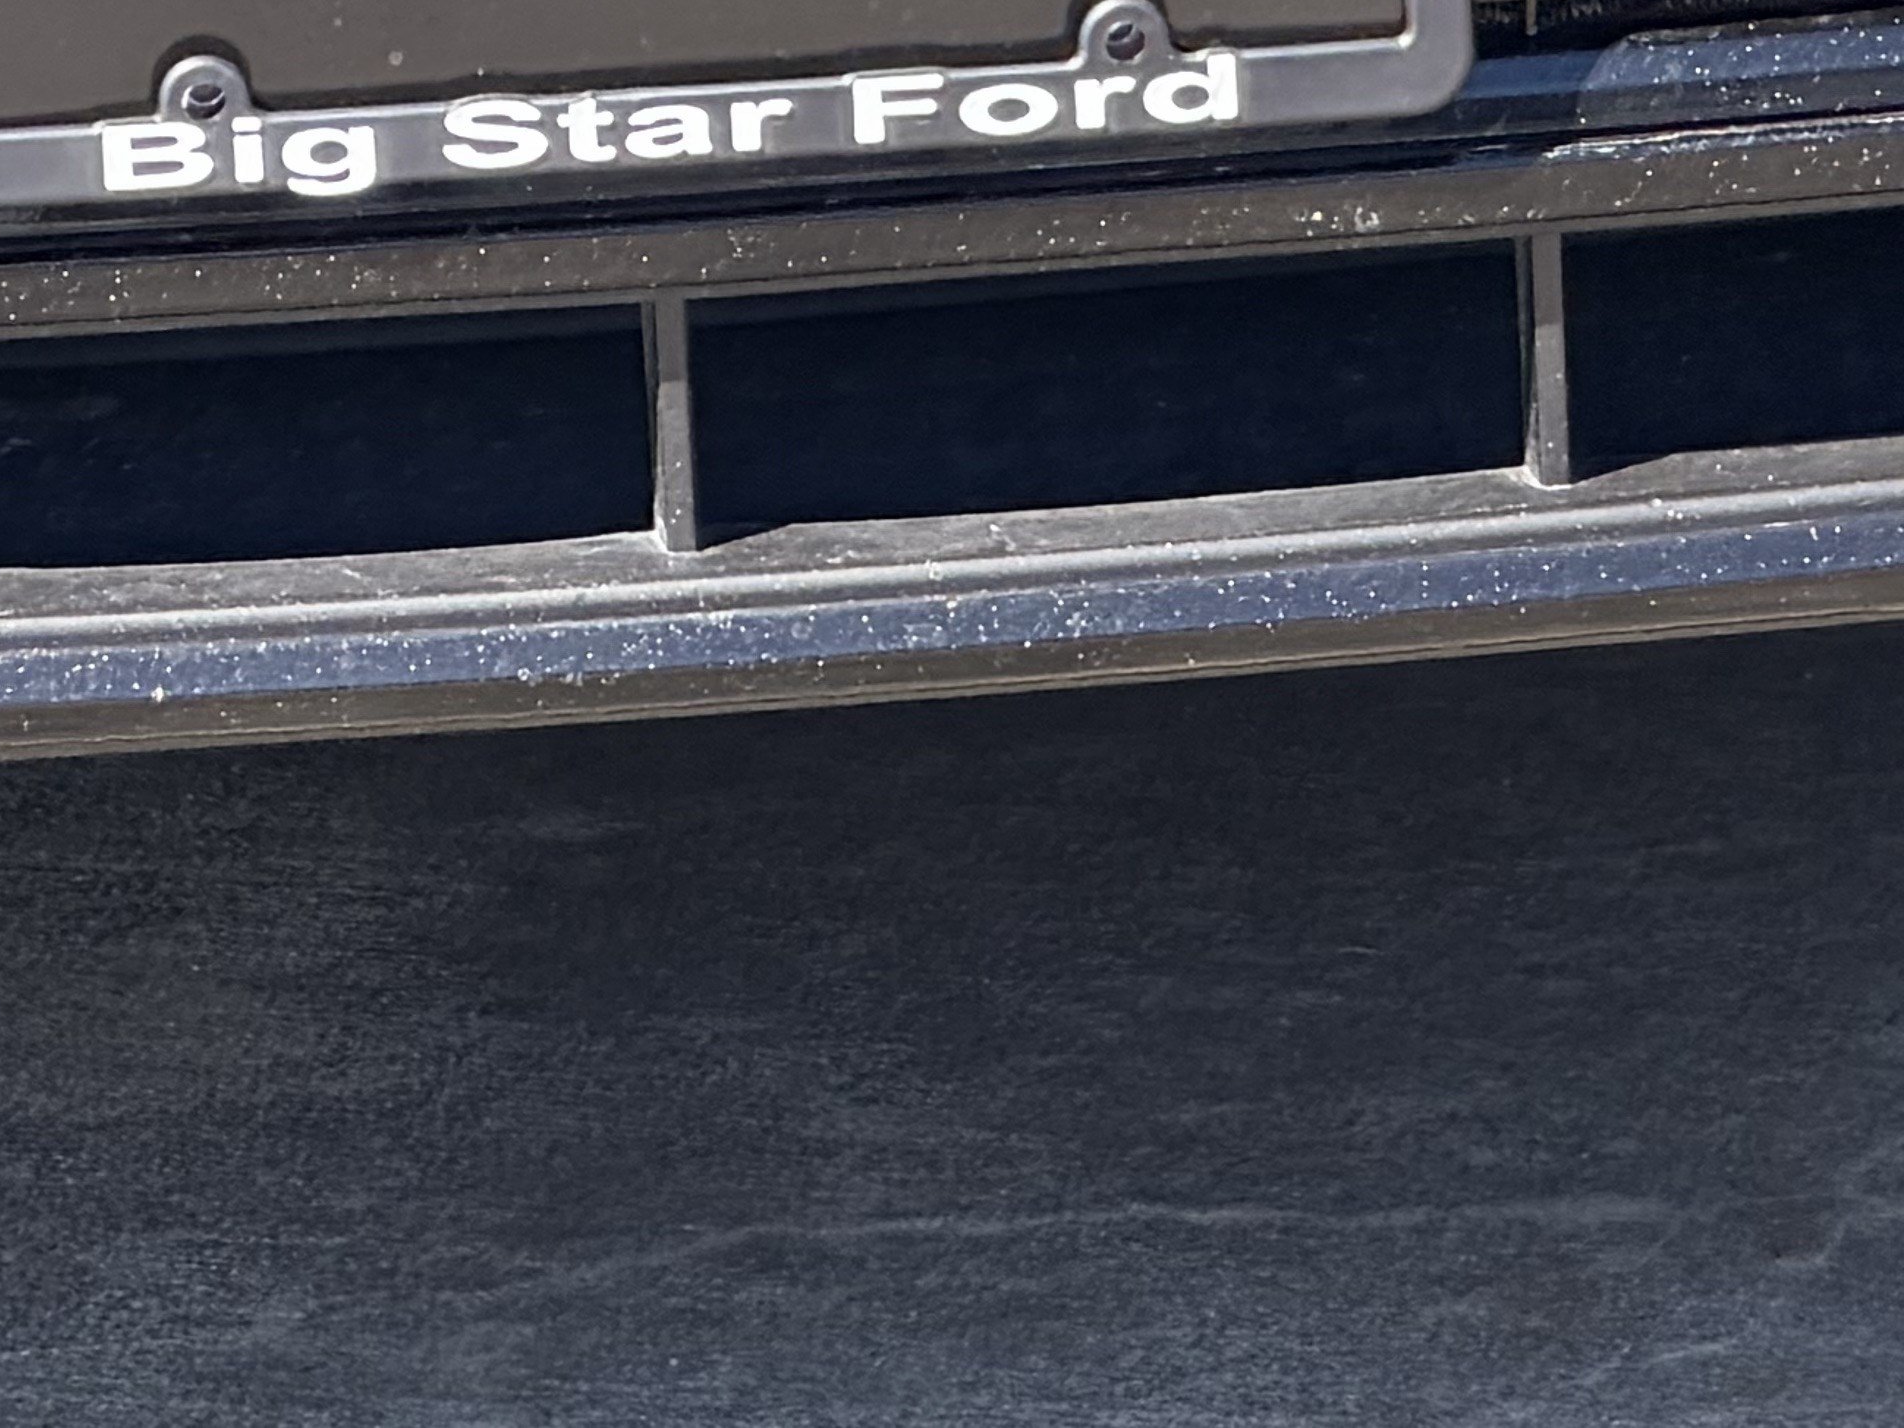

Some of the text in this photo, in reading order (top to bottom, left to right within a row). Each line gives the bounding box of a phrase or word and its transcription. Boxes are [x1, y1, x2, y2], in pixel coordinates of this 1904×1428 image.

[100, 49, 1242, 197] Big Star Ford
